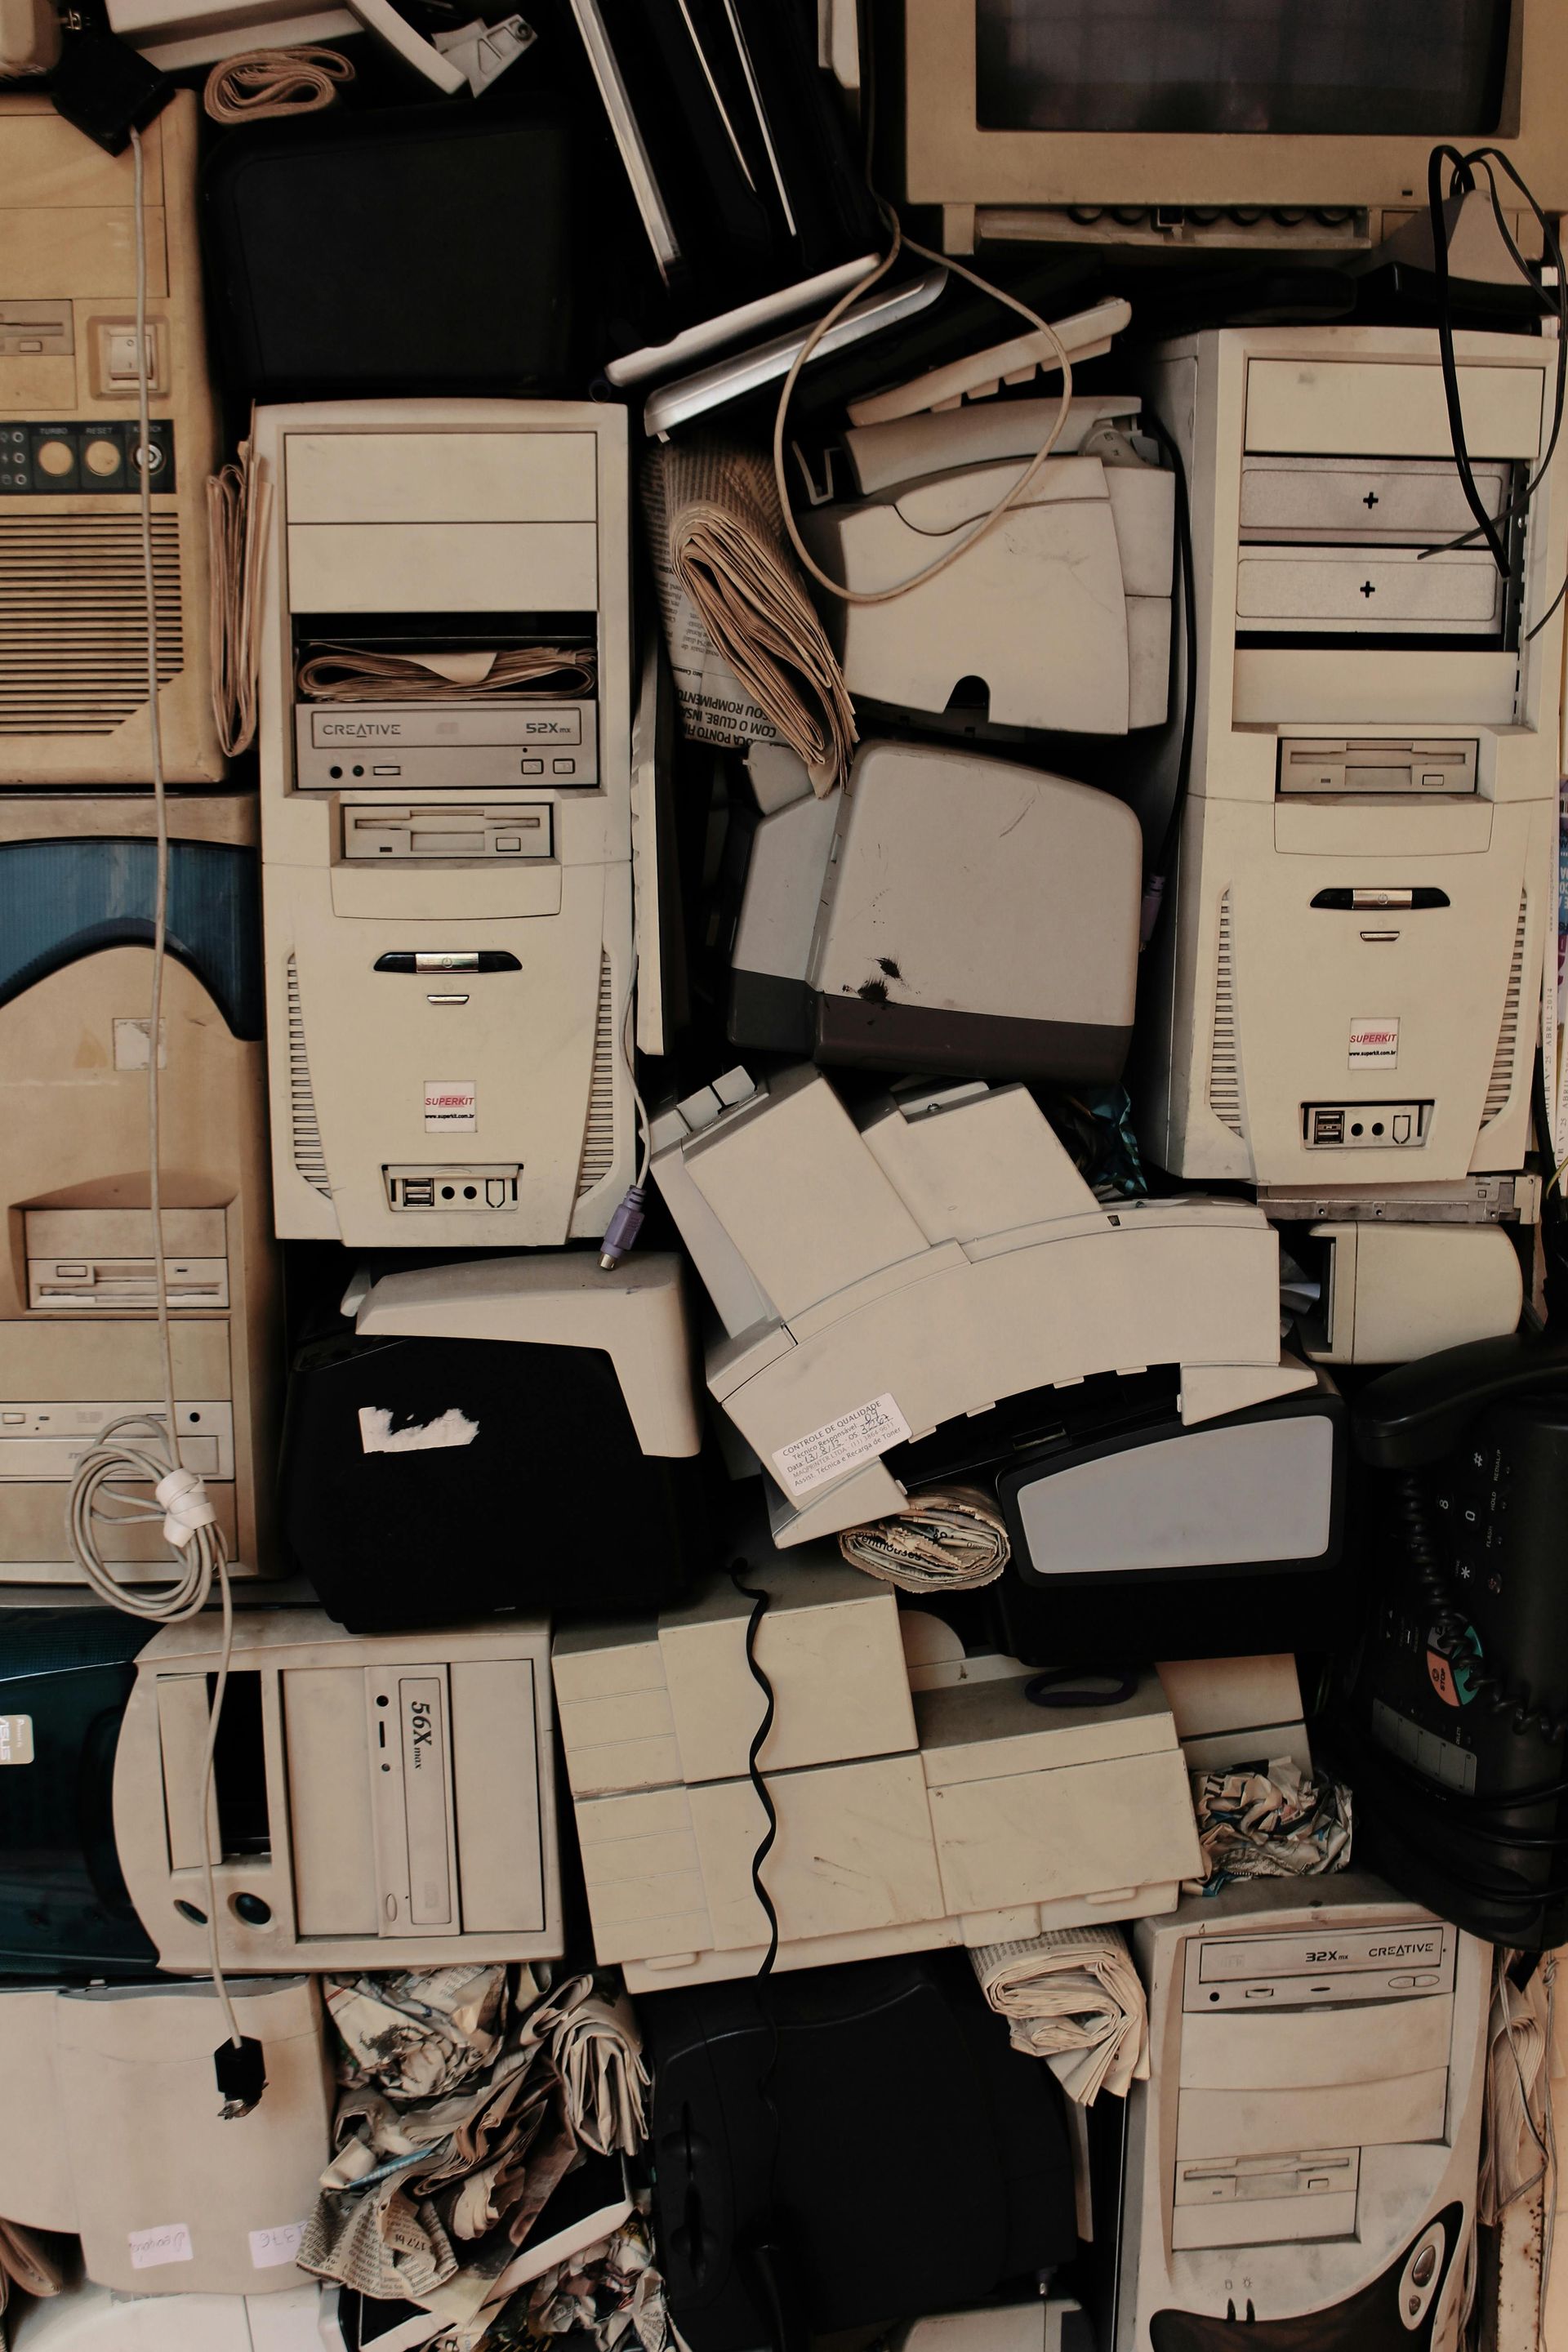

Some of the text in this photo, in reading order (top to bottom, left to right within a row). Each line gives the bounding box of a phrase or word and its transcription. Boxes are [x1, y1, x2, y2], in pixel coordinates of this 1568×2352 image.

[86, 426, 114, 434] RESET
[705, 712, 737, 729] CLUBE.
[739, 719, 748, 732] O
[323, 724, 401, 738] CREATIVE
[697, 726, 732, 744] PONTO
[750, 722, 777, 738] COM
[1350, 1033, 1397, 1043] SUPERKIT
[1545, 1054, 1552, 1063] 25
[425, 1097, 474, 1106] SUPERKIT
[782, 1400, 882, 1456] CONTROLE DE QUALIDADE
[847, 1443, 873, 1459] Recarga
[882, 1427, 902, 1439] Toner
[1439, 1499, 1449, 1510] 8
[1465, 1510, 1476, 1521] 0
[411, 1700, 432, 1770] 56X max
[1368, 1942, 1434, 1957] CREATIVE
